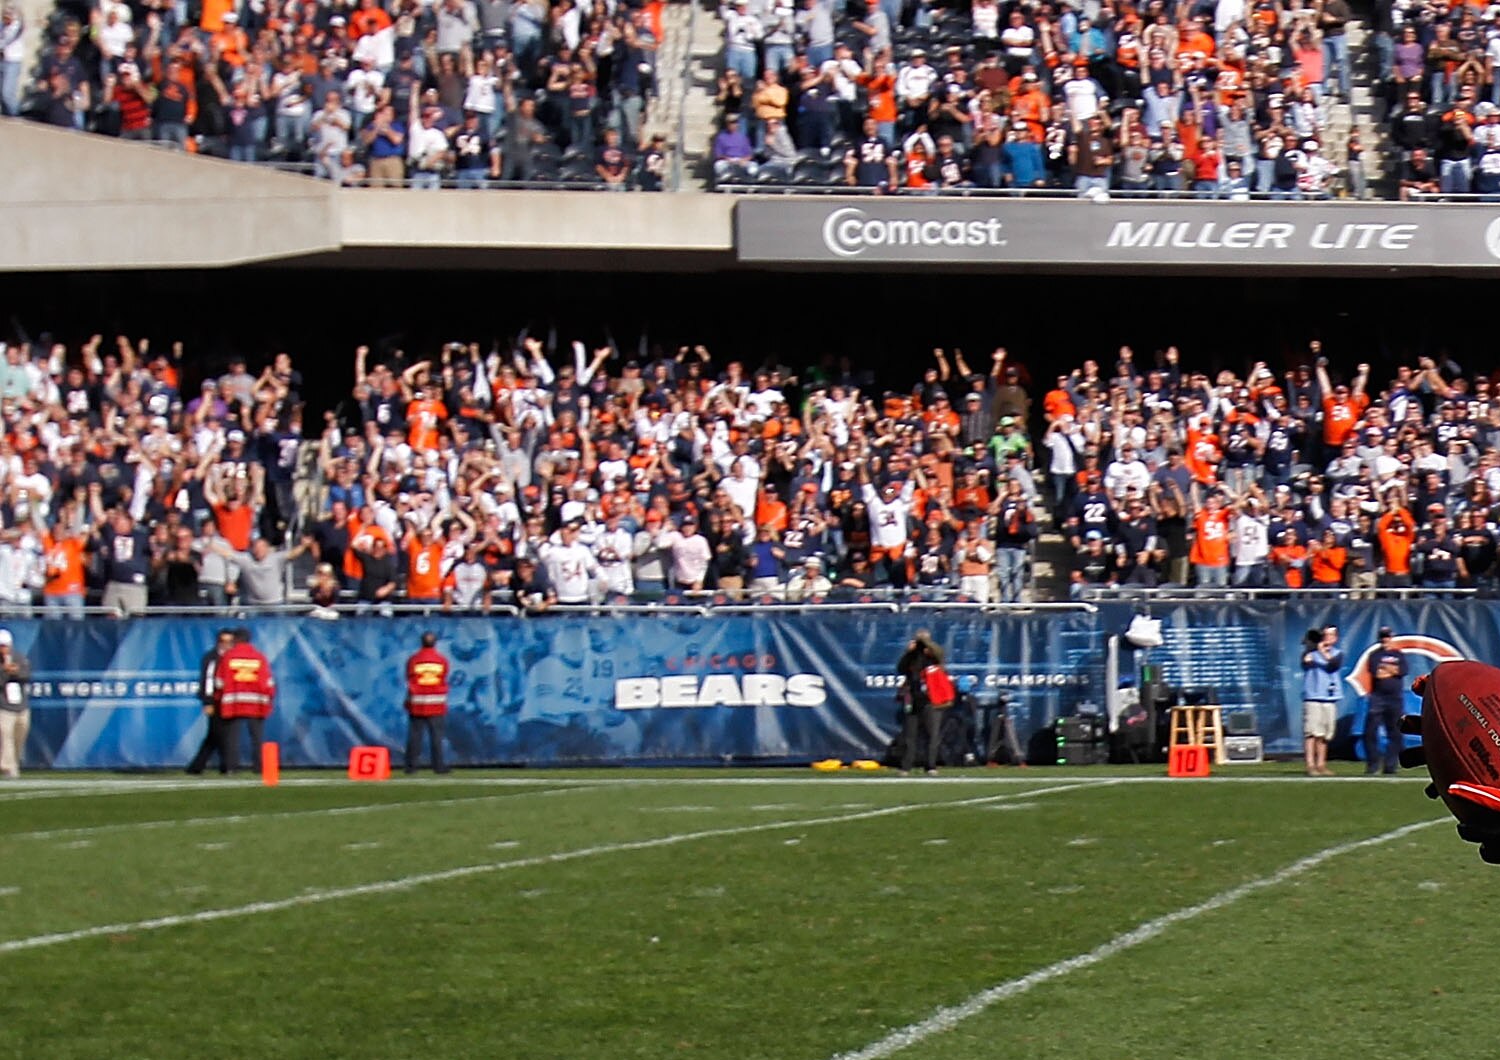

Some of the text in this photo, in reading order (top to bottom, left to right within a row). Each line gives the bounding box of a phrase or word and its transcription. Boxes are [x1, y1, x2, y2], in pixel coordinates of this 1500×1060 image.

[1105, 221, 1419, 249] MILLER LITE
[1084, 503, 1107, 523] 22
[784, 531, 805, 548] 22
[416, 551, 431, 574] 6
[58, 682, 128, 697] WORLD
[984, 673, 1089, 686] CHAMPIONS
[615, 673, 826, 710] BEARS
[1459, 693, 1489, 729] NATIONAL
[357, 752, 378, 776] G
[1176, 749, 1198, 774] 10
